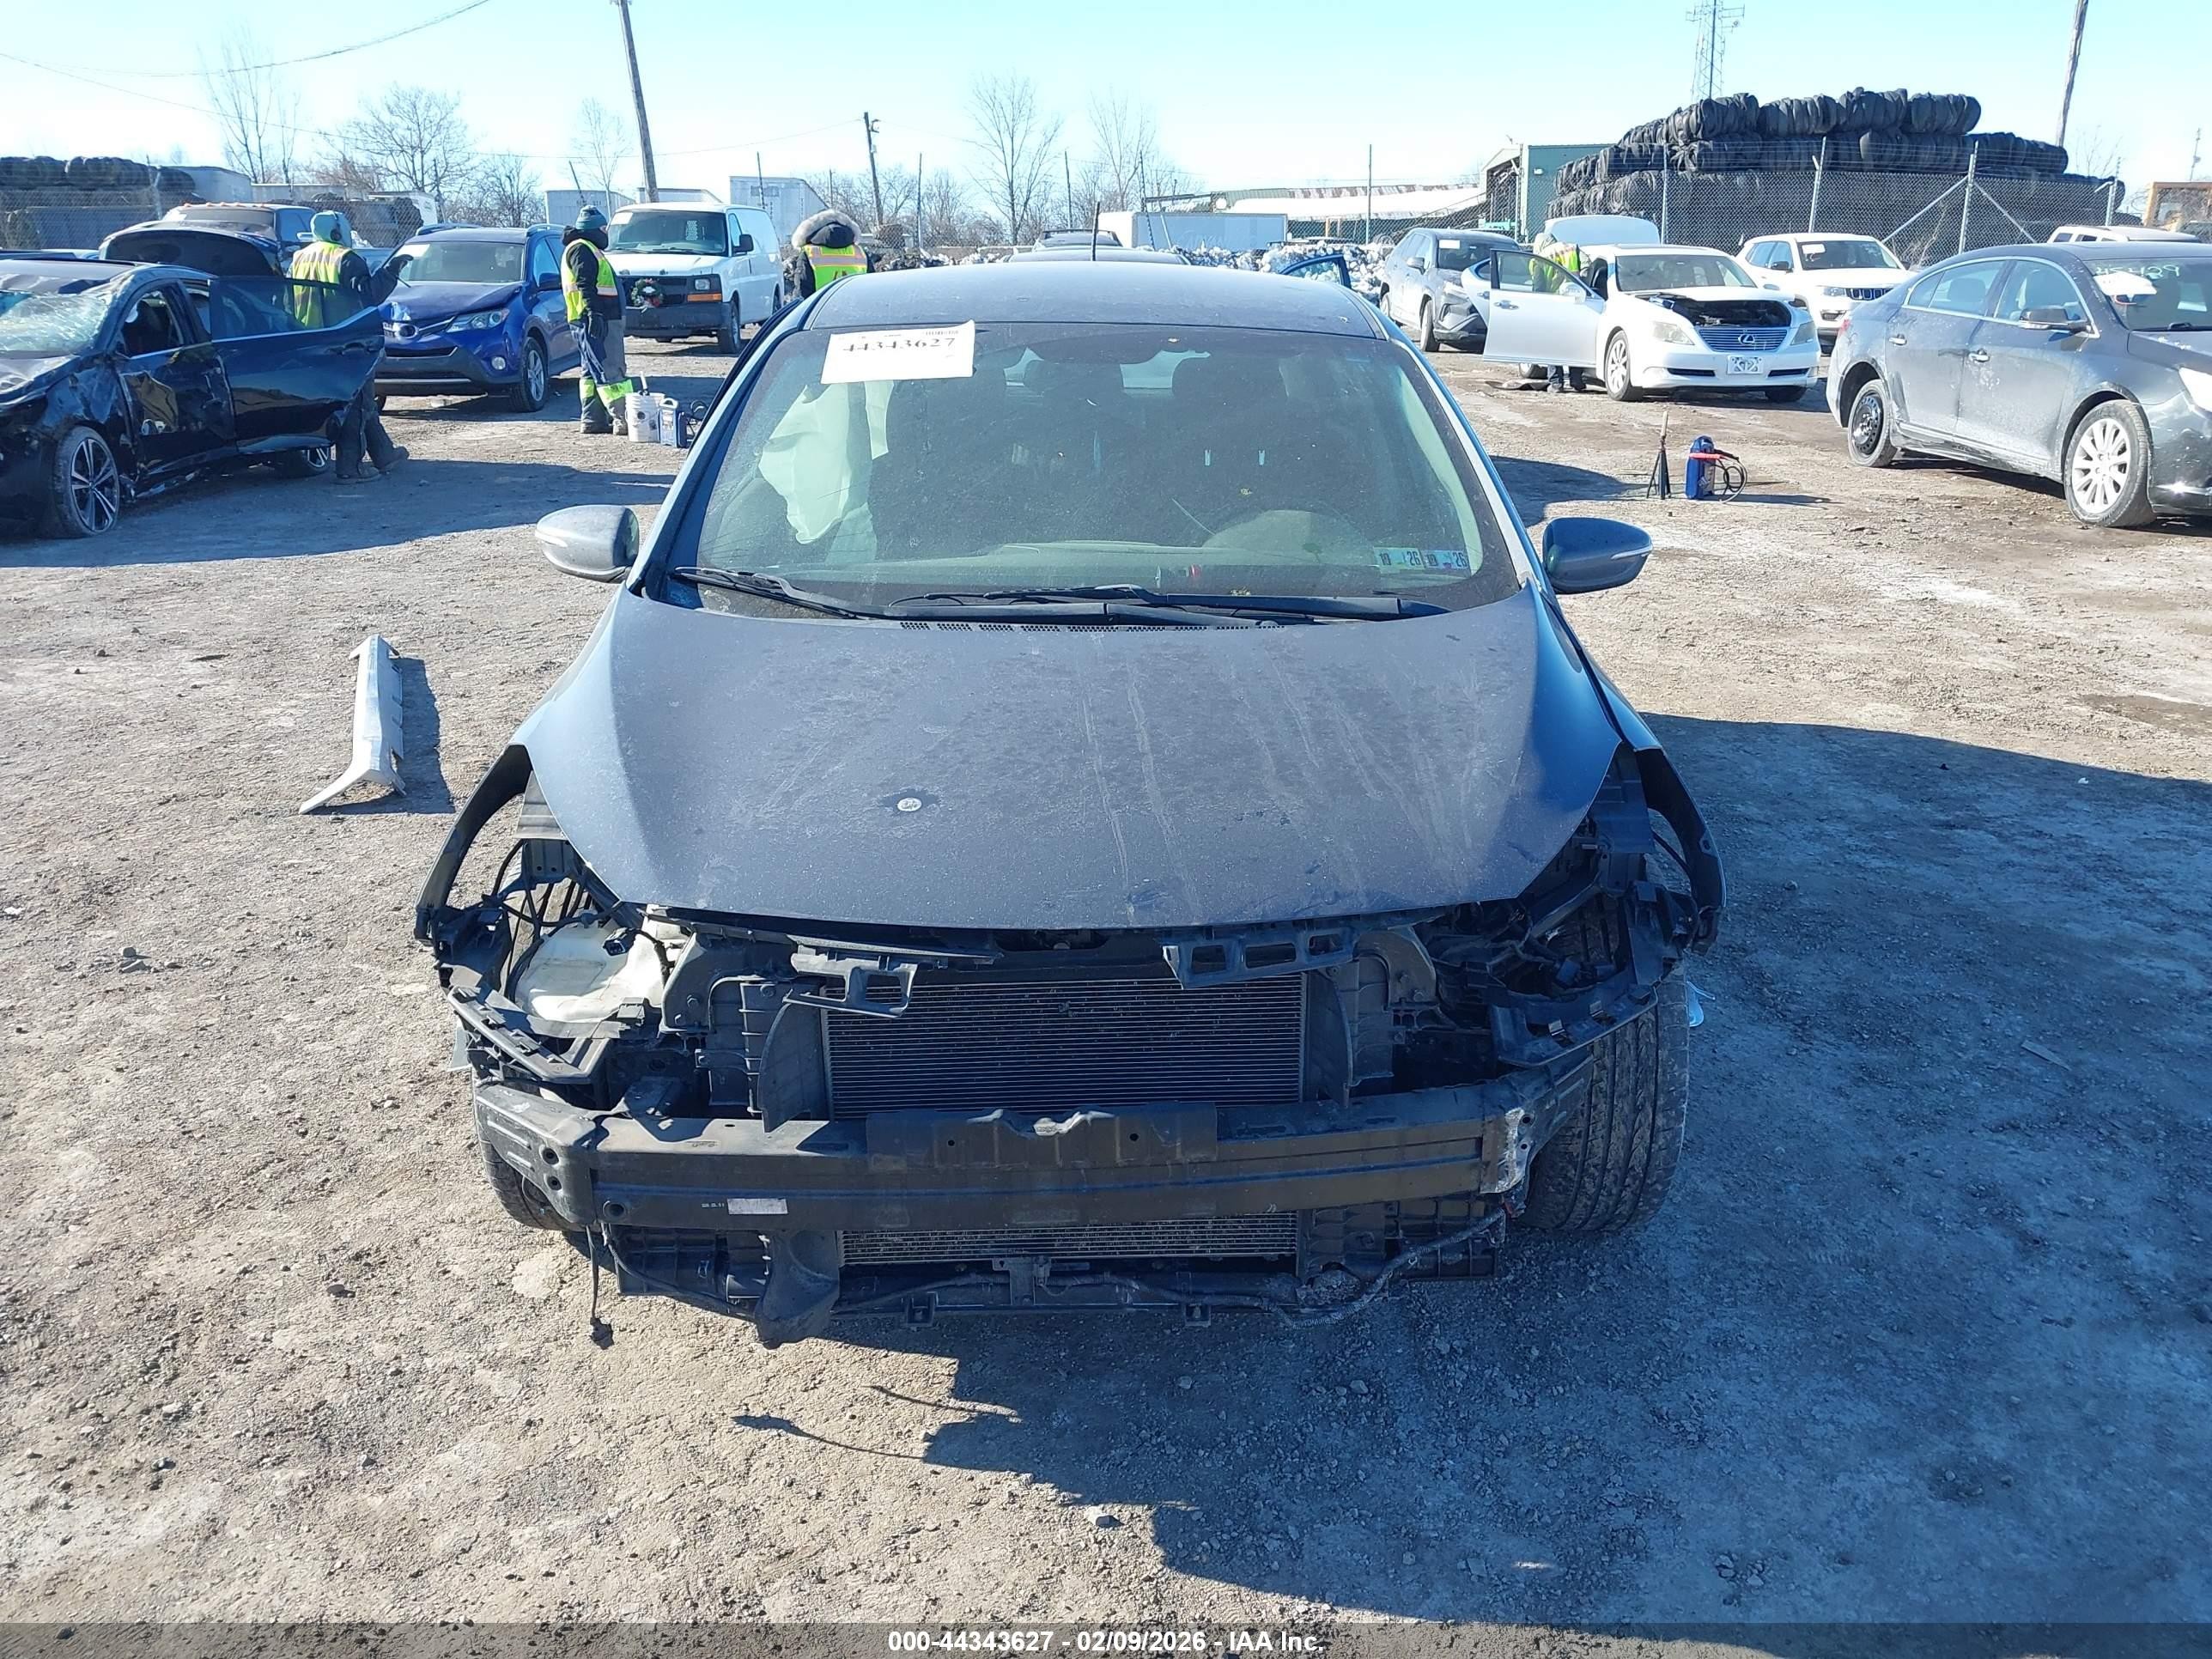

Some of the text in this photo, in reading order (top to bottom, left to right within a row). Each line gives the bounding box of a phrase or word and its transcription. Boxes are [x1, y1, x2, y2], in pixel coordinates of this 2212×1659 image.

[842, 337, 956, 352] 44343627
[1407, 550, 1421, 566] 26
[1452, 552, 1468, 568] 26
